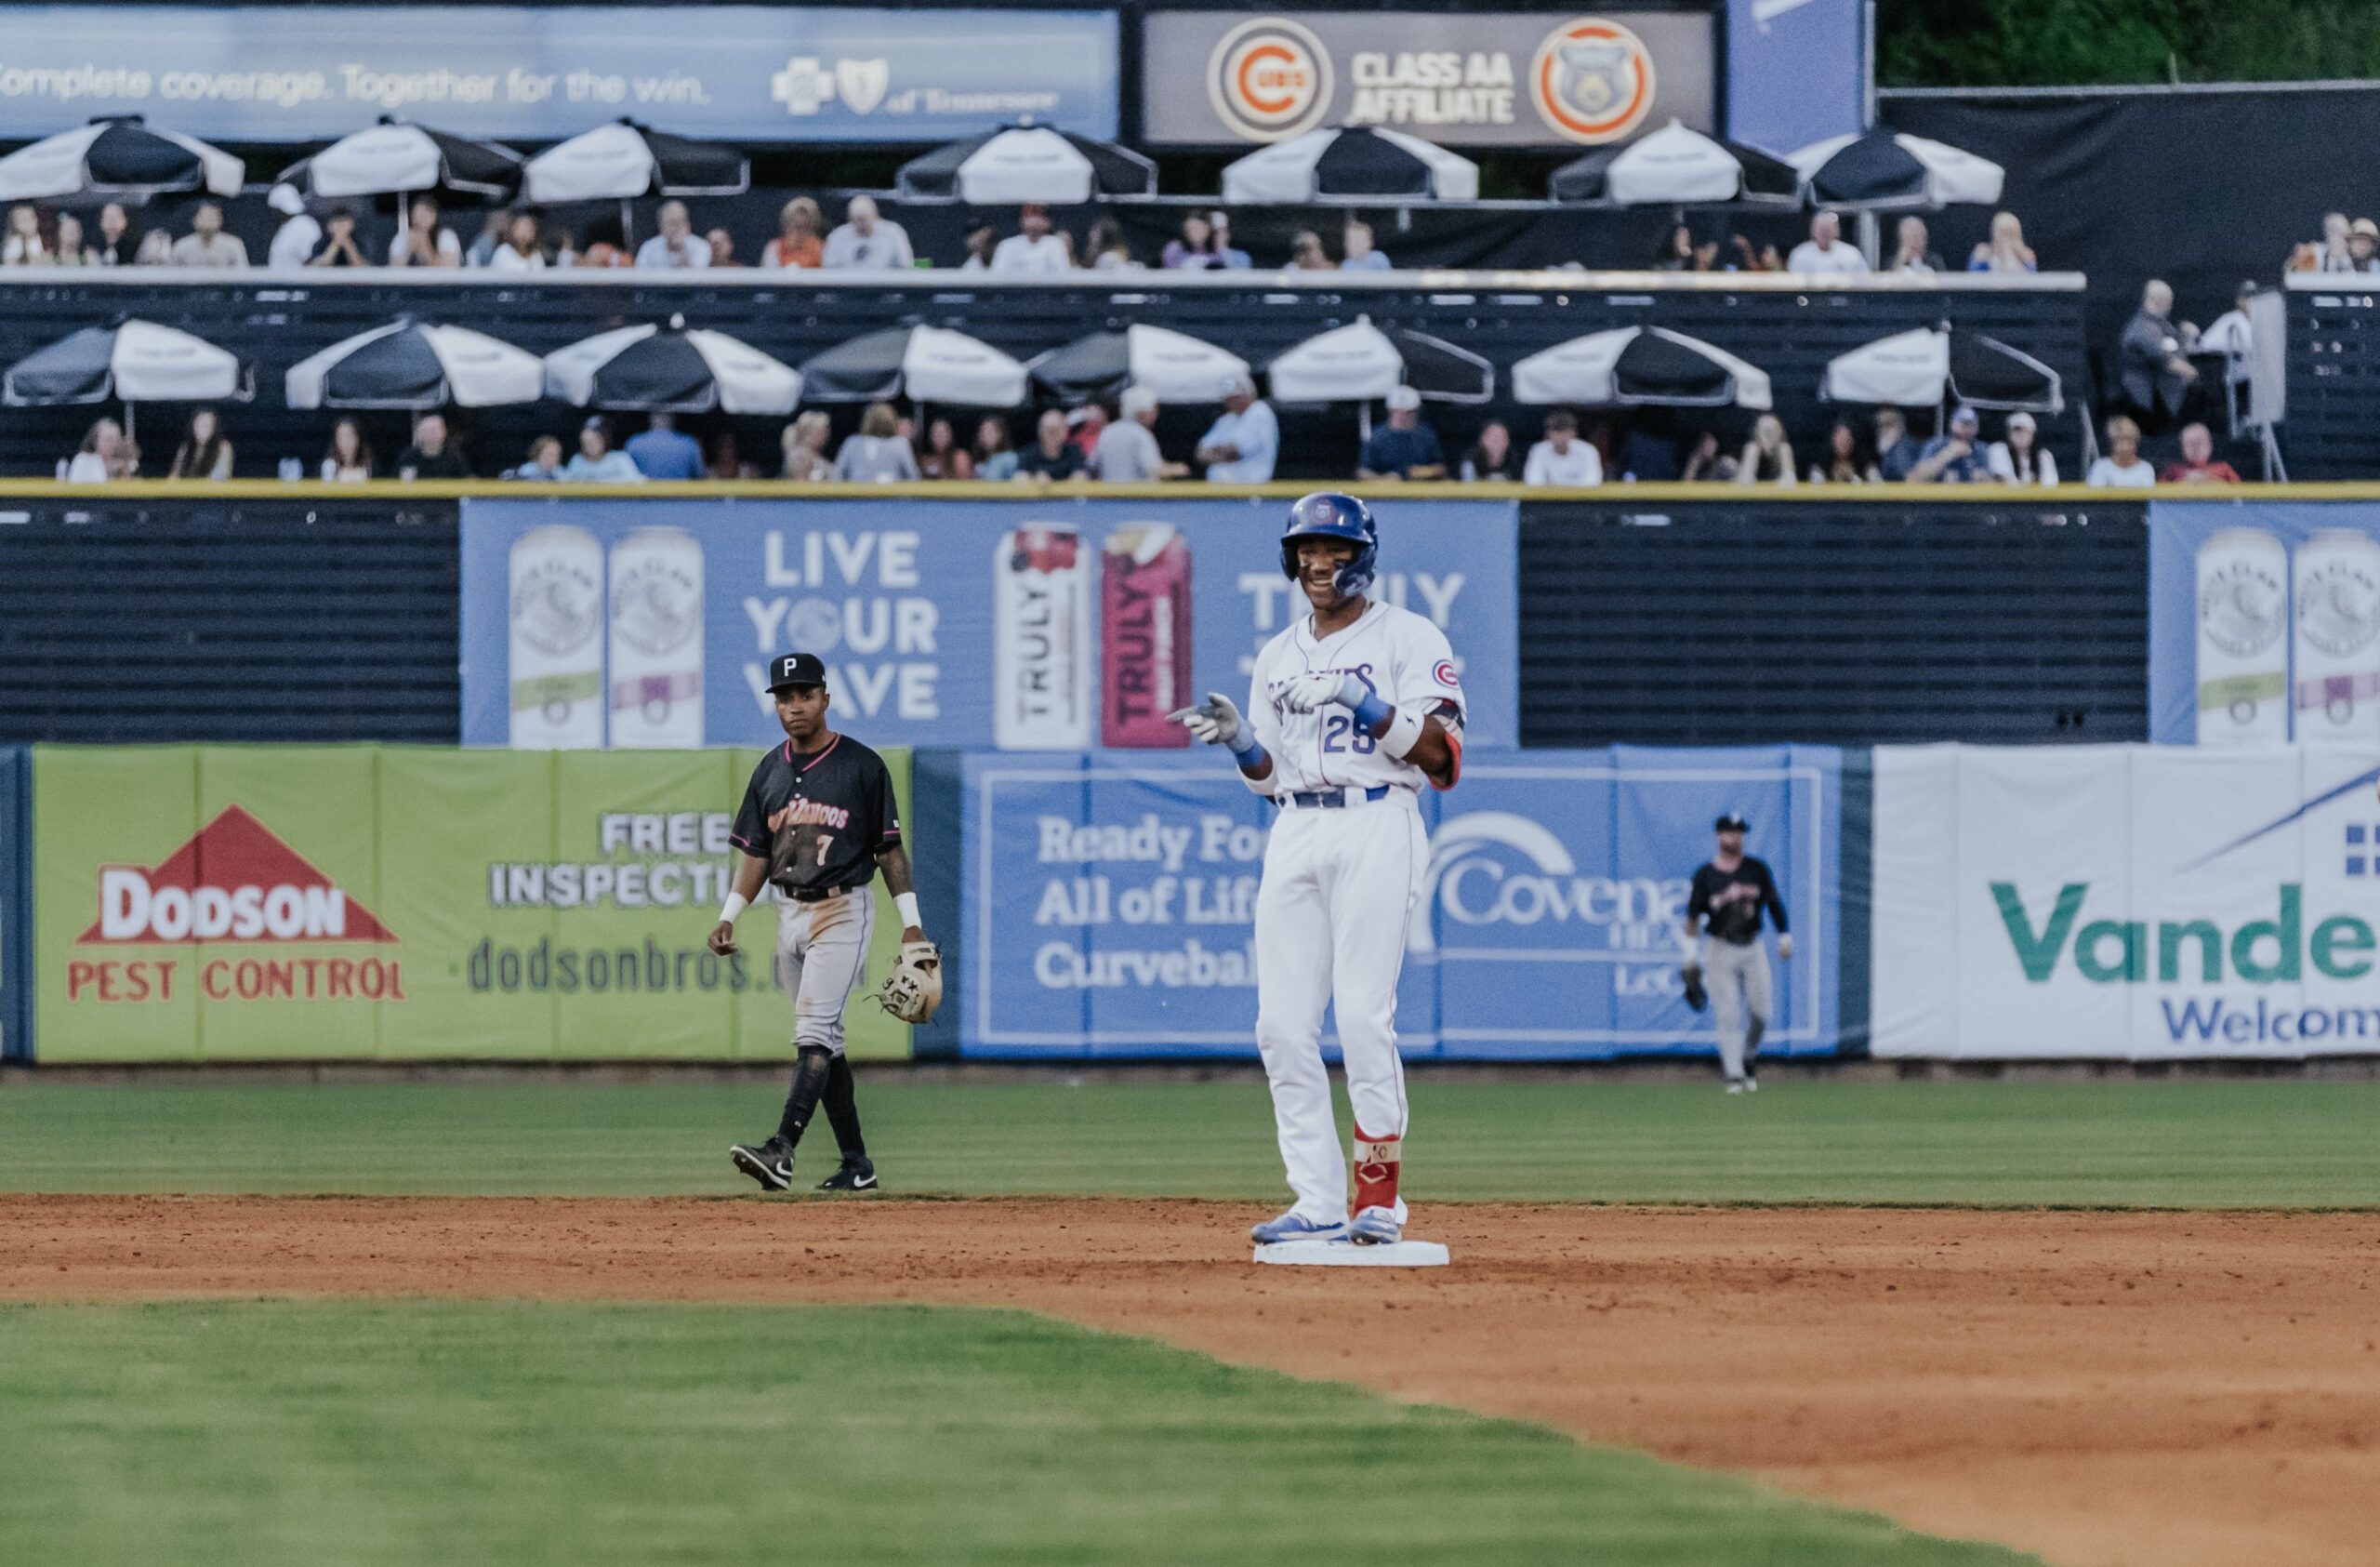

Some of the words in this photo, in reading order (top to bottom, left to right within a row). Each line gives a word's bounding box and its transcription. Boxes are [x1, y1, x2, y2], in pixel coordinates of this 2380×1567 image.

[0, 62, 152, 103] omplete
[340, 63, 497, 109] Together
[507, 66, 555, 104] for
[565, 67, 627, 104] the
[1352, 51, 1462, 88] CLASS
[1463, 51, 1514, 88] AA
[1353, 87, 1515, 125] AFFILIATE
[765, 530, 921, 588] LIVE
[745, 597, 940, 653] YOUR
[784, 657, 797, 677] P
[1017, 578, 1051, 724] TRULY
[1117, 578, 1153, 727] TRULY
[600, 812, 731, 856] FREE
[816, 834, 835, 867] 7
[1037, 813, 1192, 872] Ready
[489, 863, 777, 908] INSPECTI
[1034, 876, 1112, 925] All
[1118, 876, 1175, 924] of
[1440, 857, 1692, 925] Covena
[1988, 882, 2377, 985] Vande
[67, 960, 178, 1003] PEST
[201, 958, 406, 1003] CONTROL
[469, 936, 787, 991] dodsonbros.
[1033, 938, 1258, 989] Curvebal
